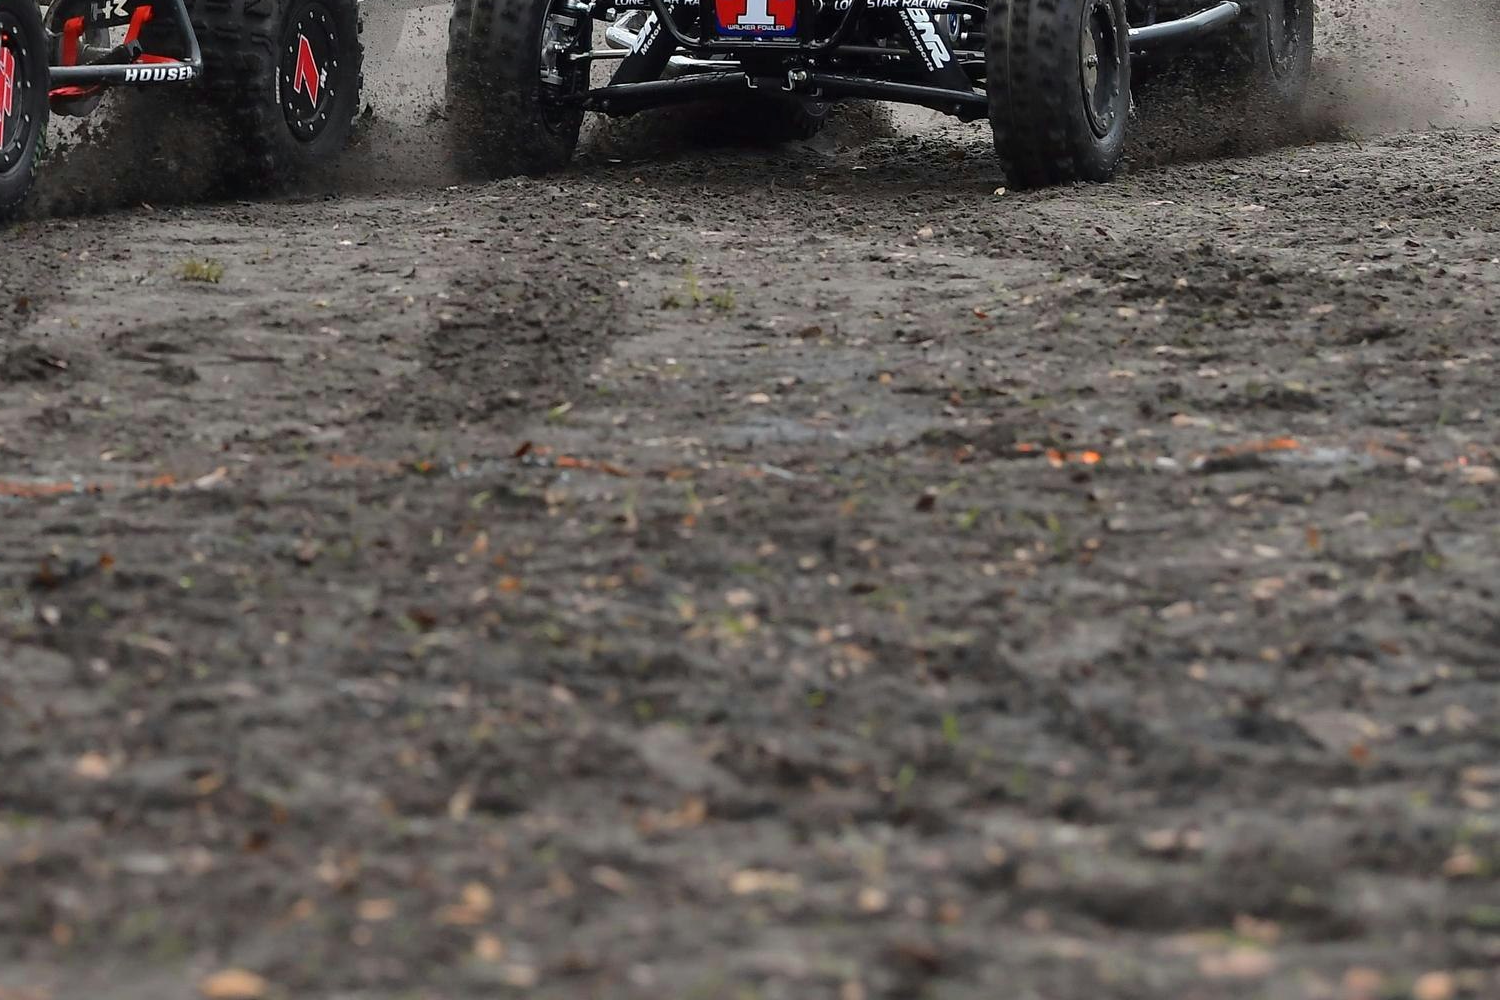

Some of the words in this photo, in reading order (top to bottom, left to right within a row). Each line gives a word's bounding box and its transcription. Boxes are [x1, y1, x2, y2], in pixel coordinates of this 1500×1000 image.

[899, 10, 934, 72] Motorsports
[907, 7, 951, 69] BNR
[124, 66, 194, 82] HOUSER
